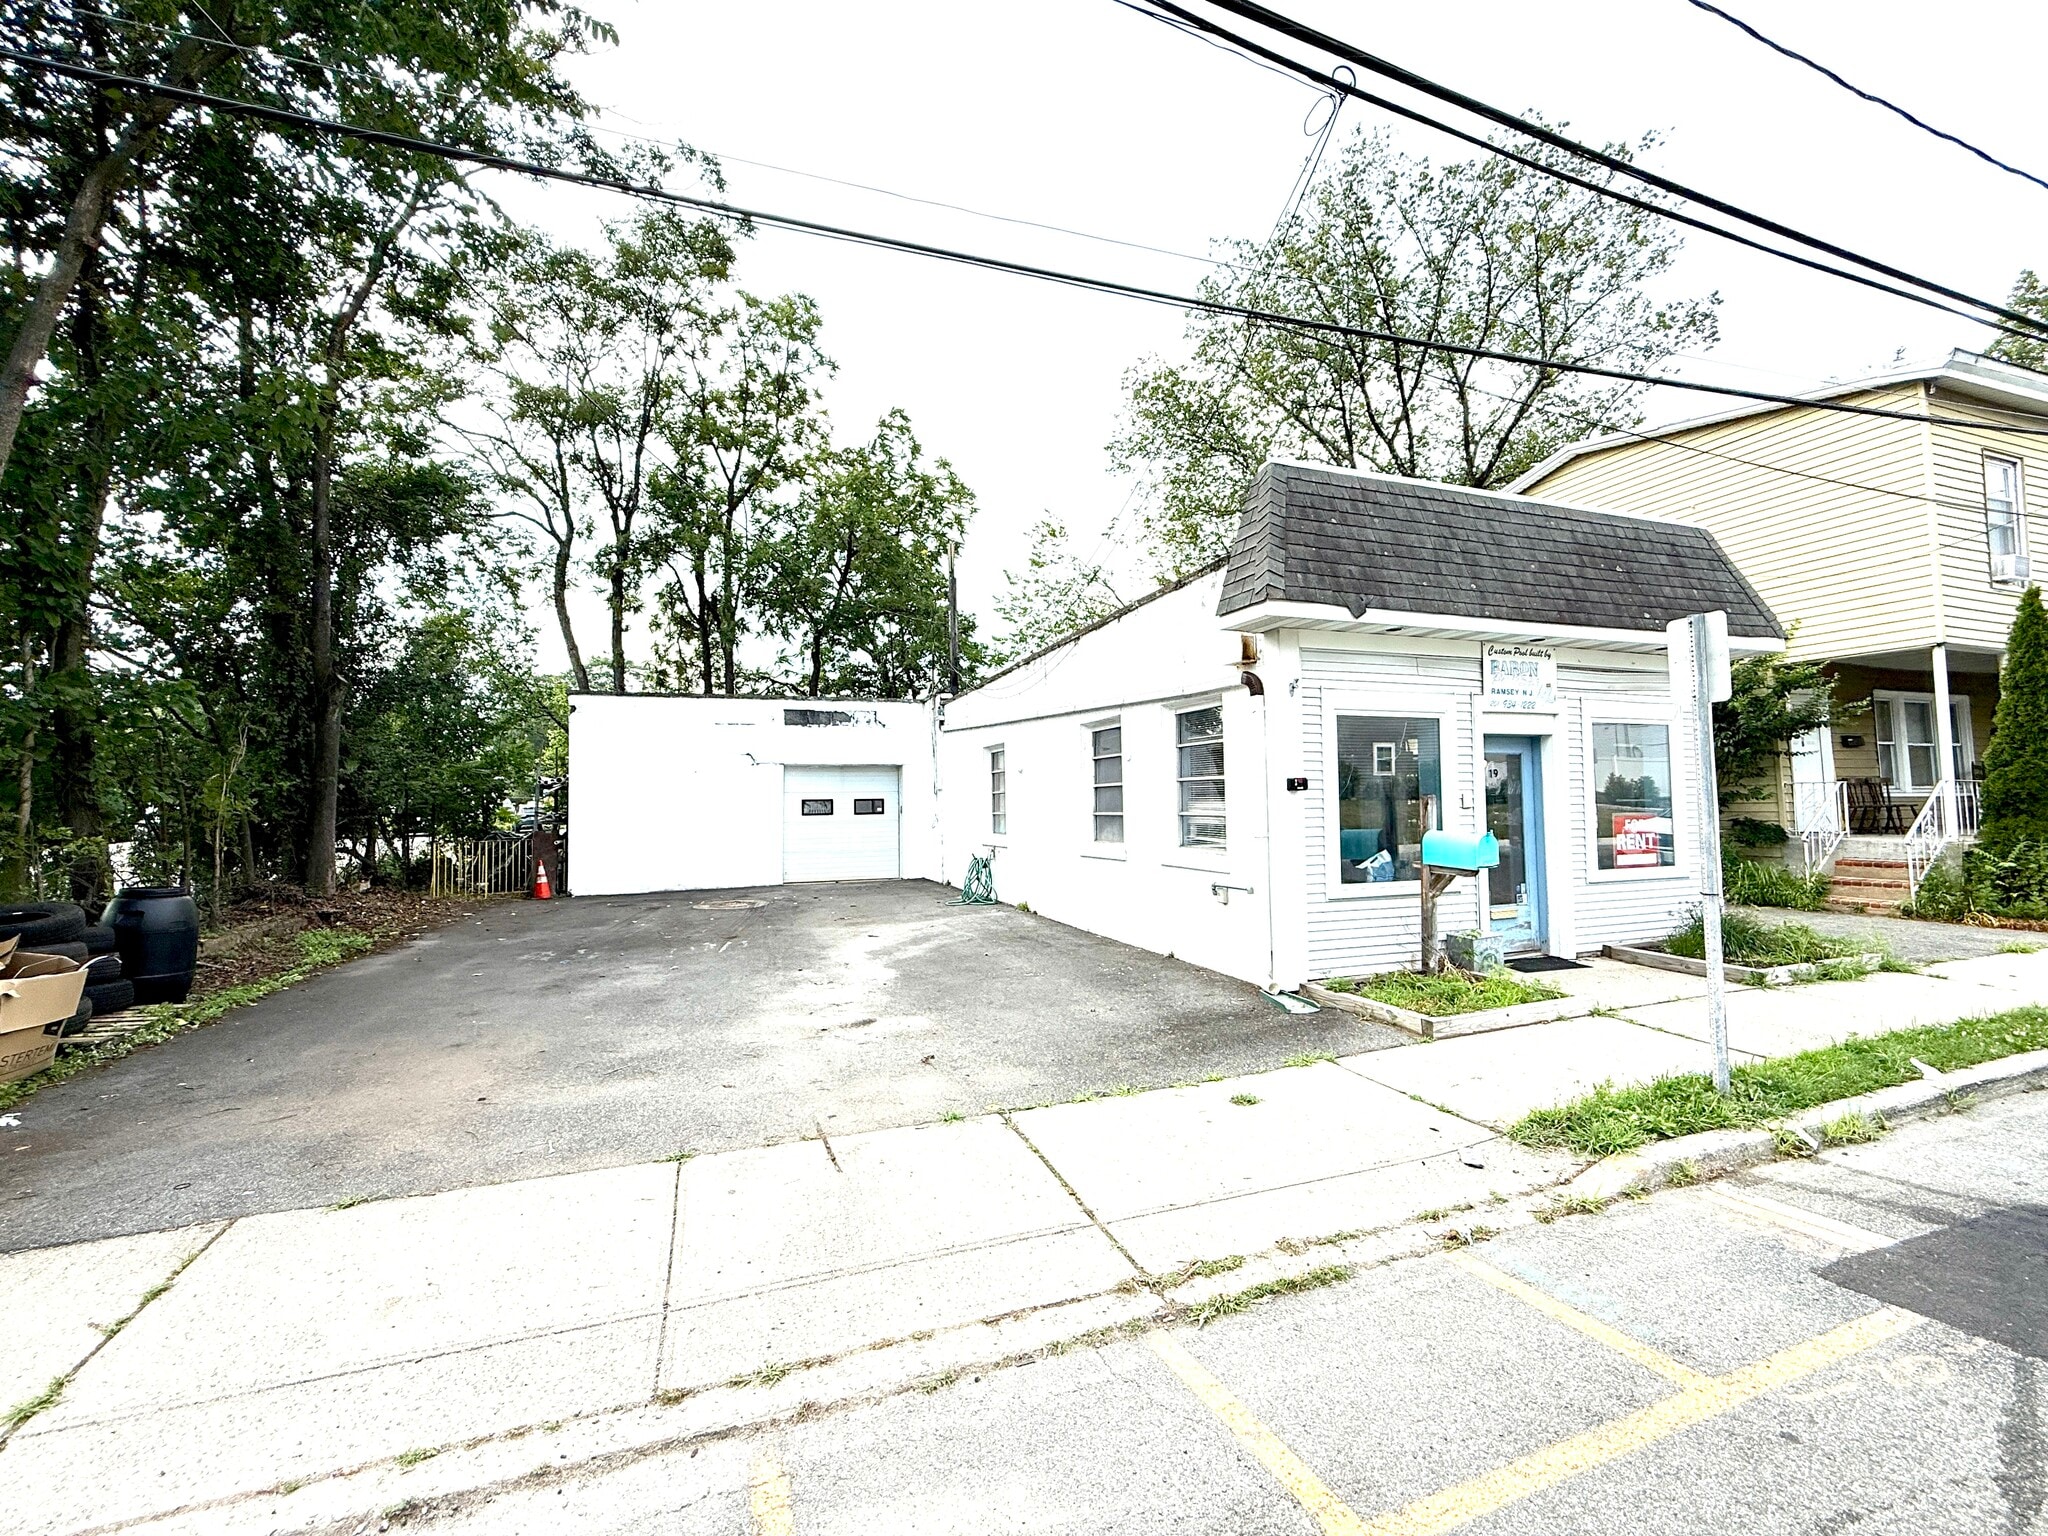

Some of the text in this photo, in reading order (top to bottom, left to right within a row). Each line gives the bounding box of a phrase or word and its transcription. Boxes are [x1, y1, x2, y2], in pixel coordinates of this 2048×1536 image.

[1488, 645, 1551, 660] Custom Pool built by
[1489, 769, 1498, 778] 19
[1616, 833, 1656, 850] RENT
